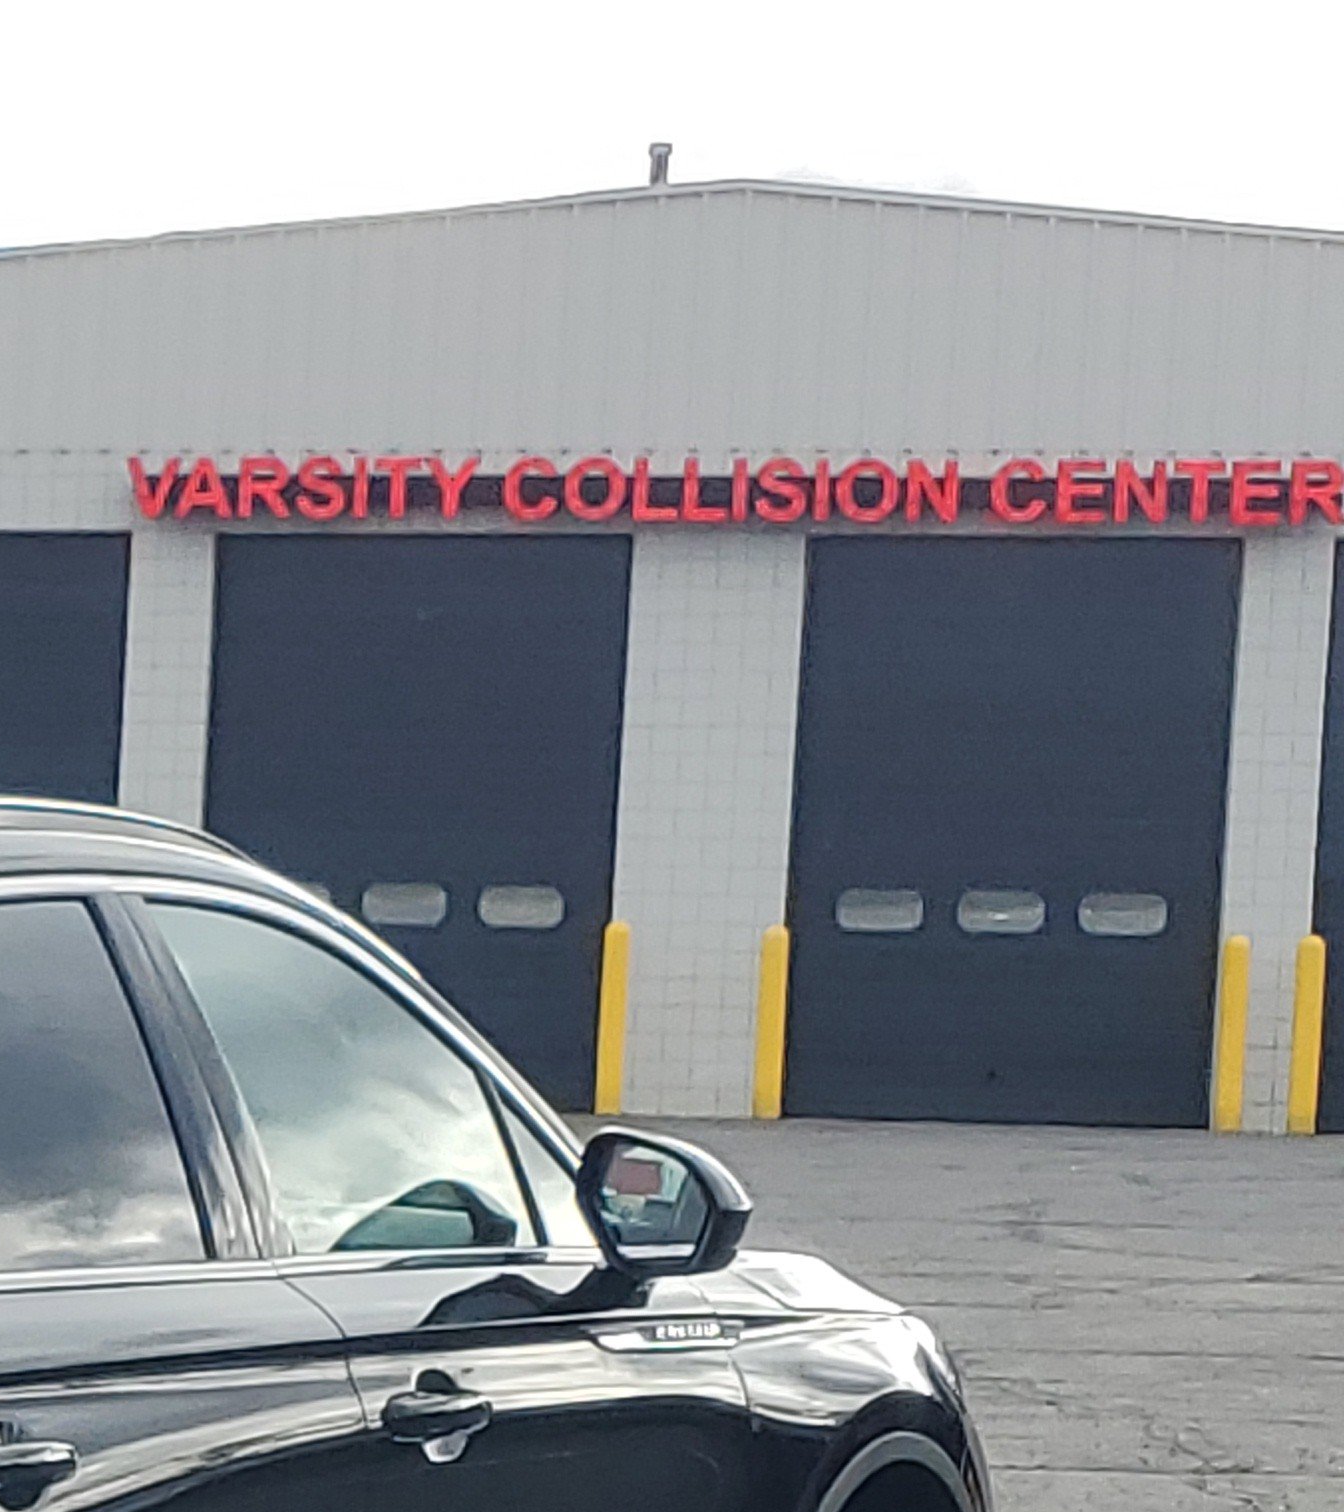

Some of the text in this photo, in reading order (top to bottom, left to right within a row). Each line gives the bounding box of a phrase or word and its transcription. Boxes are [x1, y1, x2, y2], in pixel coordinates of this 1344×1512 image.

[126, 454, 1344, 527] VARSITY COLLISION CENTER
